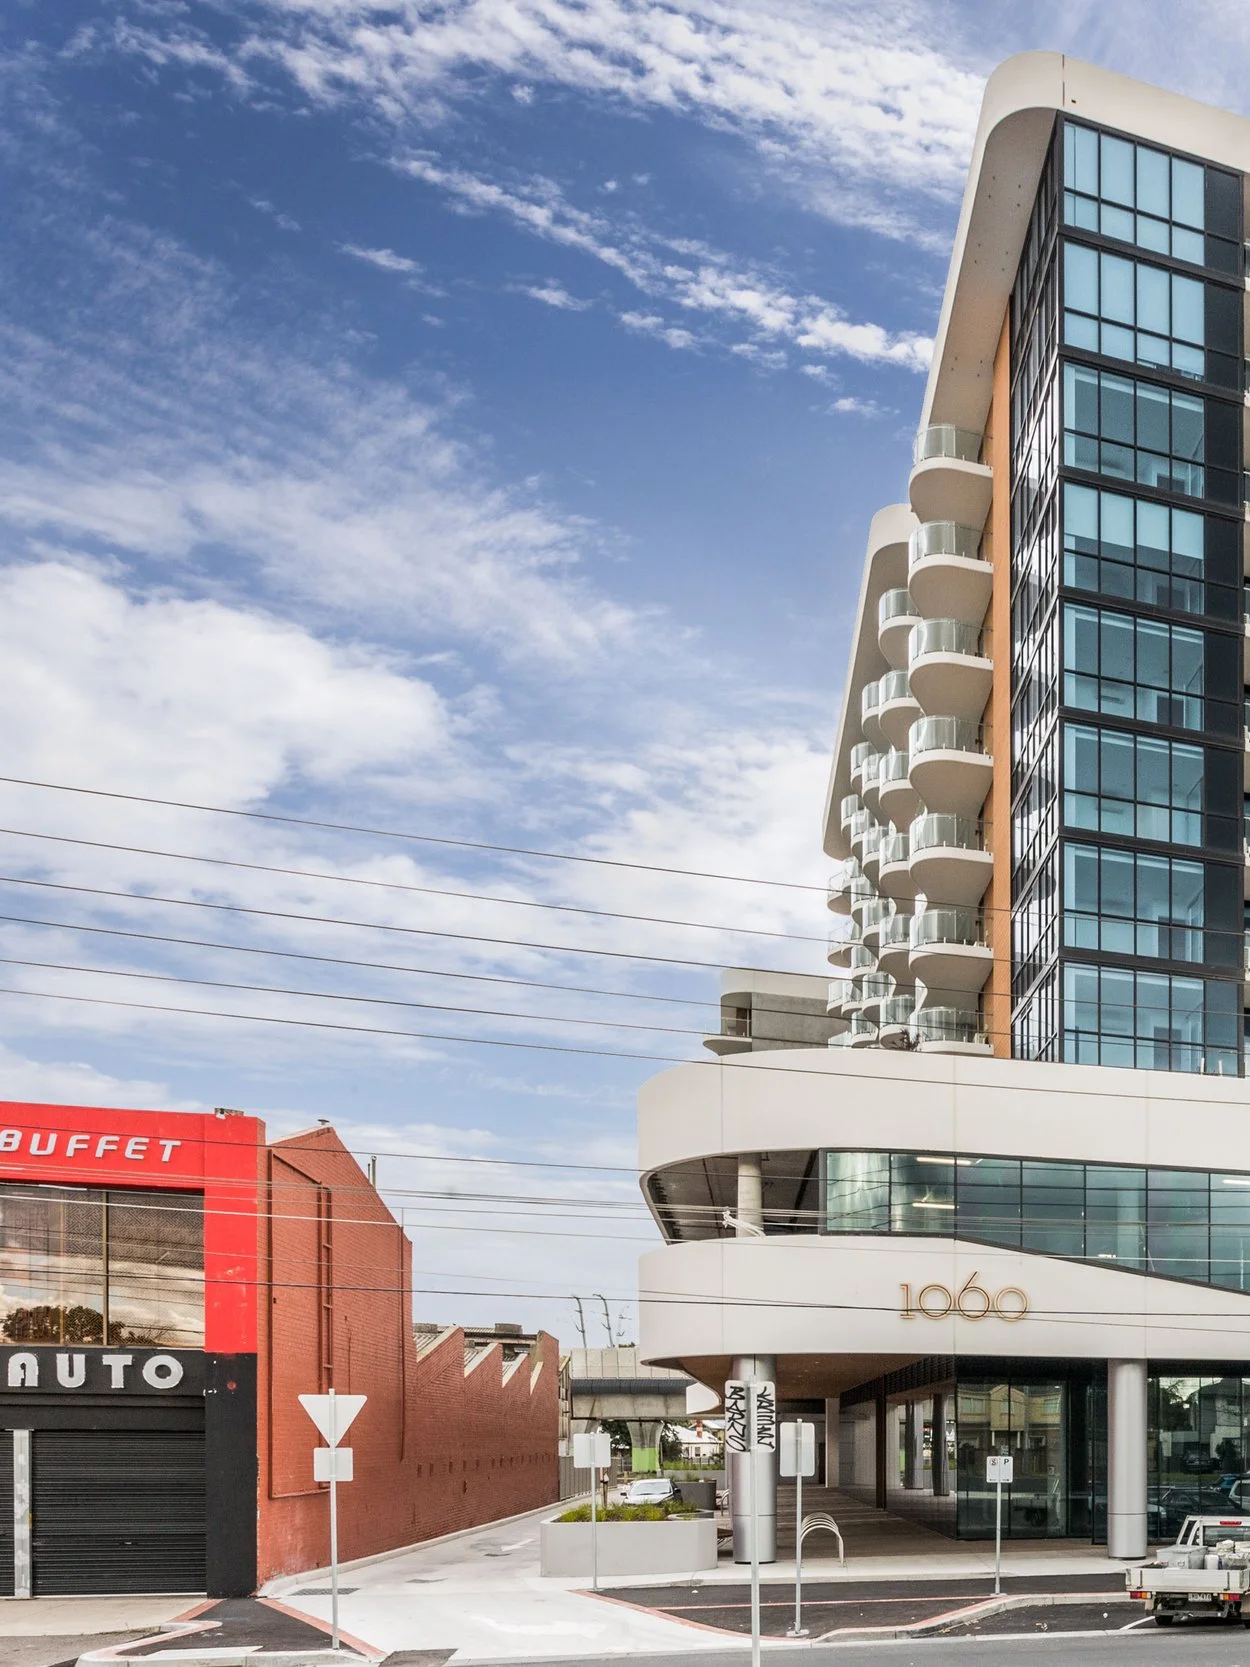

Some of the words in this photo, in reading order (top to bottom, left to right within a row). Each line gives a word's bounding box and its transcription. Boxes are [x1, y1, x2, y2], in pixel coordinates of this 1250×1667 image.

[0, 1129, 182, 1162] BUFFET
[899, 1271, 1030, 1322] 1060
[7, 1352, 184, 1389] AUTO
